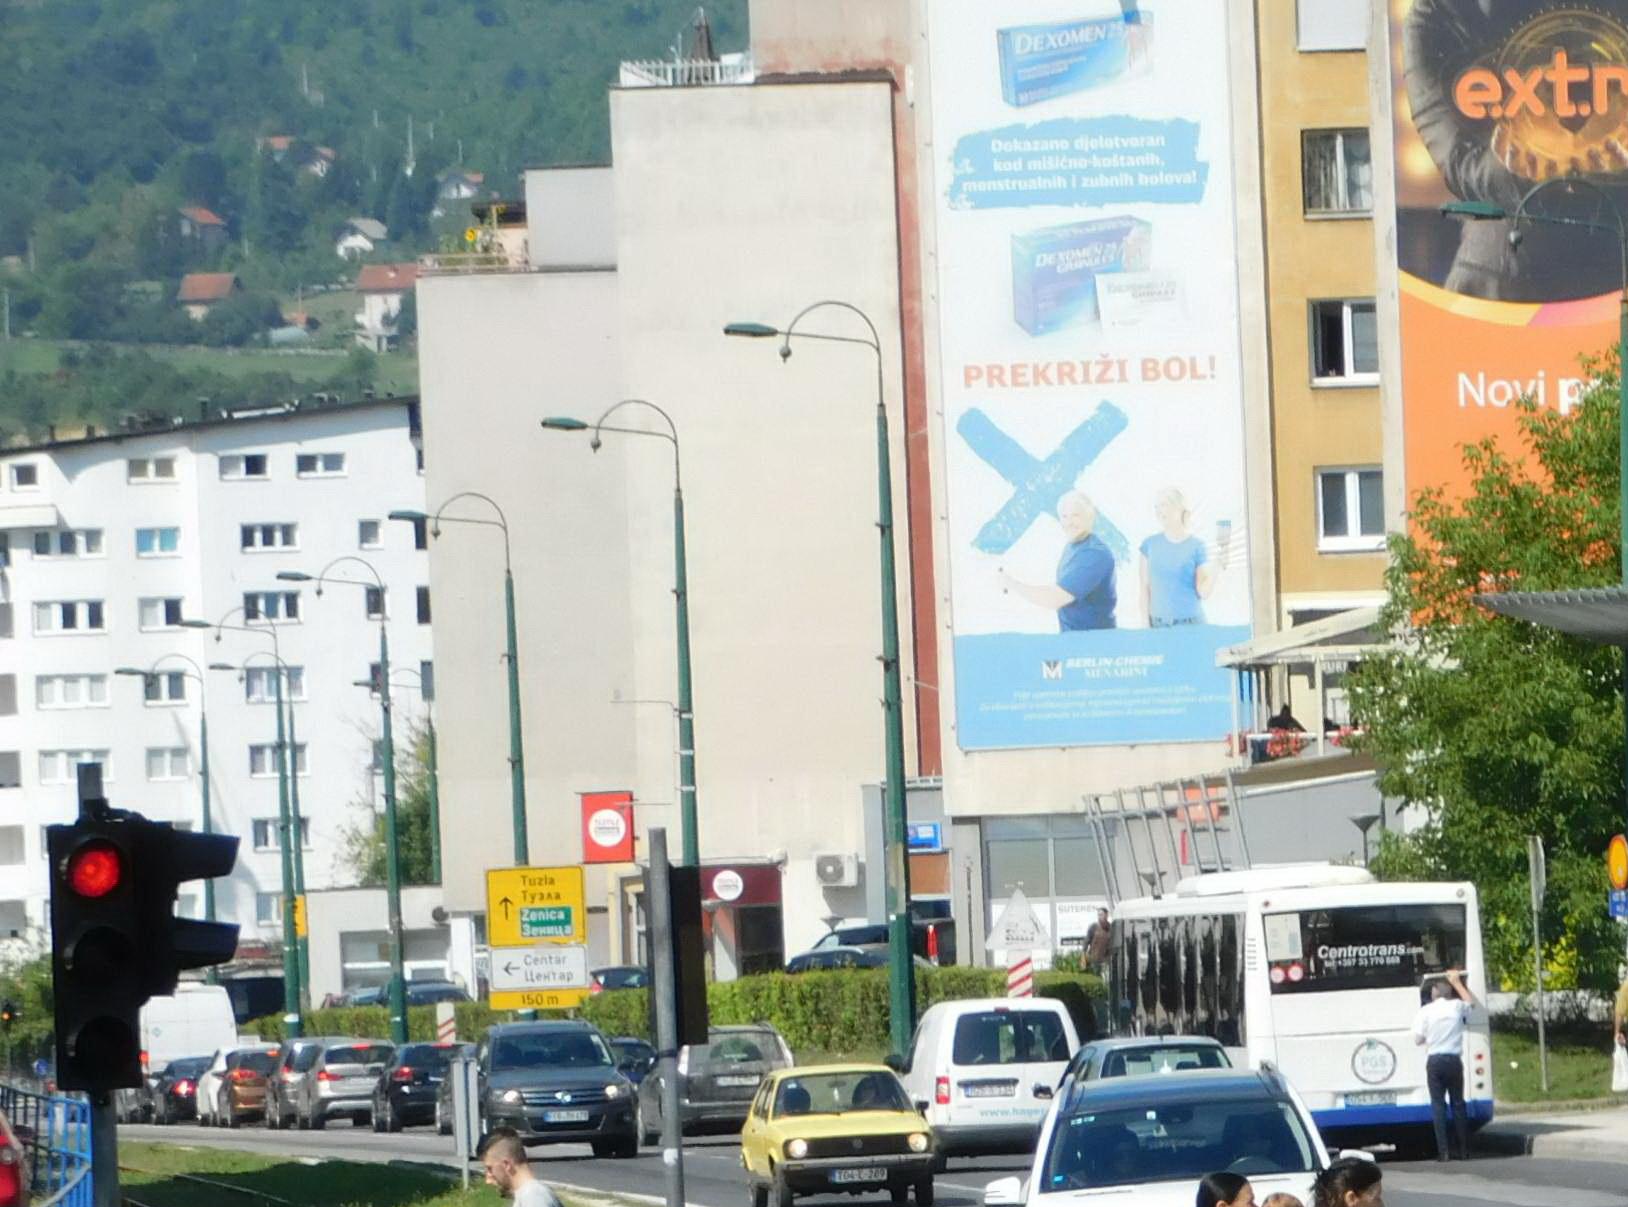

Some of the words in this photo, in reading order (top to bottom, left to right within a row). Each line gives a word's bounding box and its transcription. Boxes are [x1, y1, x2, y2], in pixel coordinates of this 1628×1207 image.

[993, 158, 1024, 172] kod
[963, 353, 1128, 388] PREKRIŽI
[1141, 355, 1216, 383] BOL!
[1457, 370, 1545, 408] Novi
[521, 874, 555, 886] Tuzla
[521, 908, 565, 922] Zenica
[524, 954, 567, 966] Centar
[524, 970, 573, 982] Центар
[521, 994, 543, 1005] 150
[546, 996, 559, 1005] m
